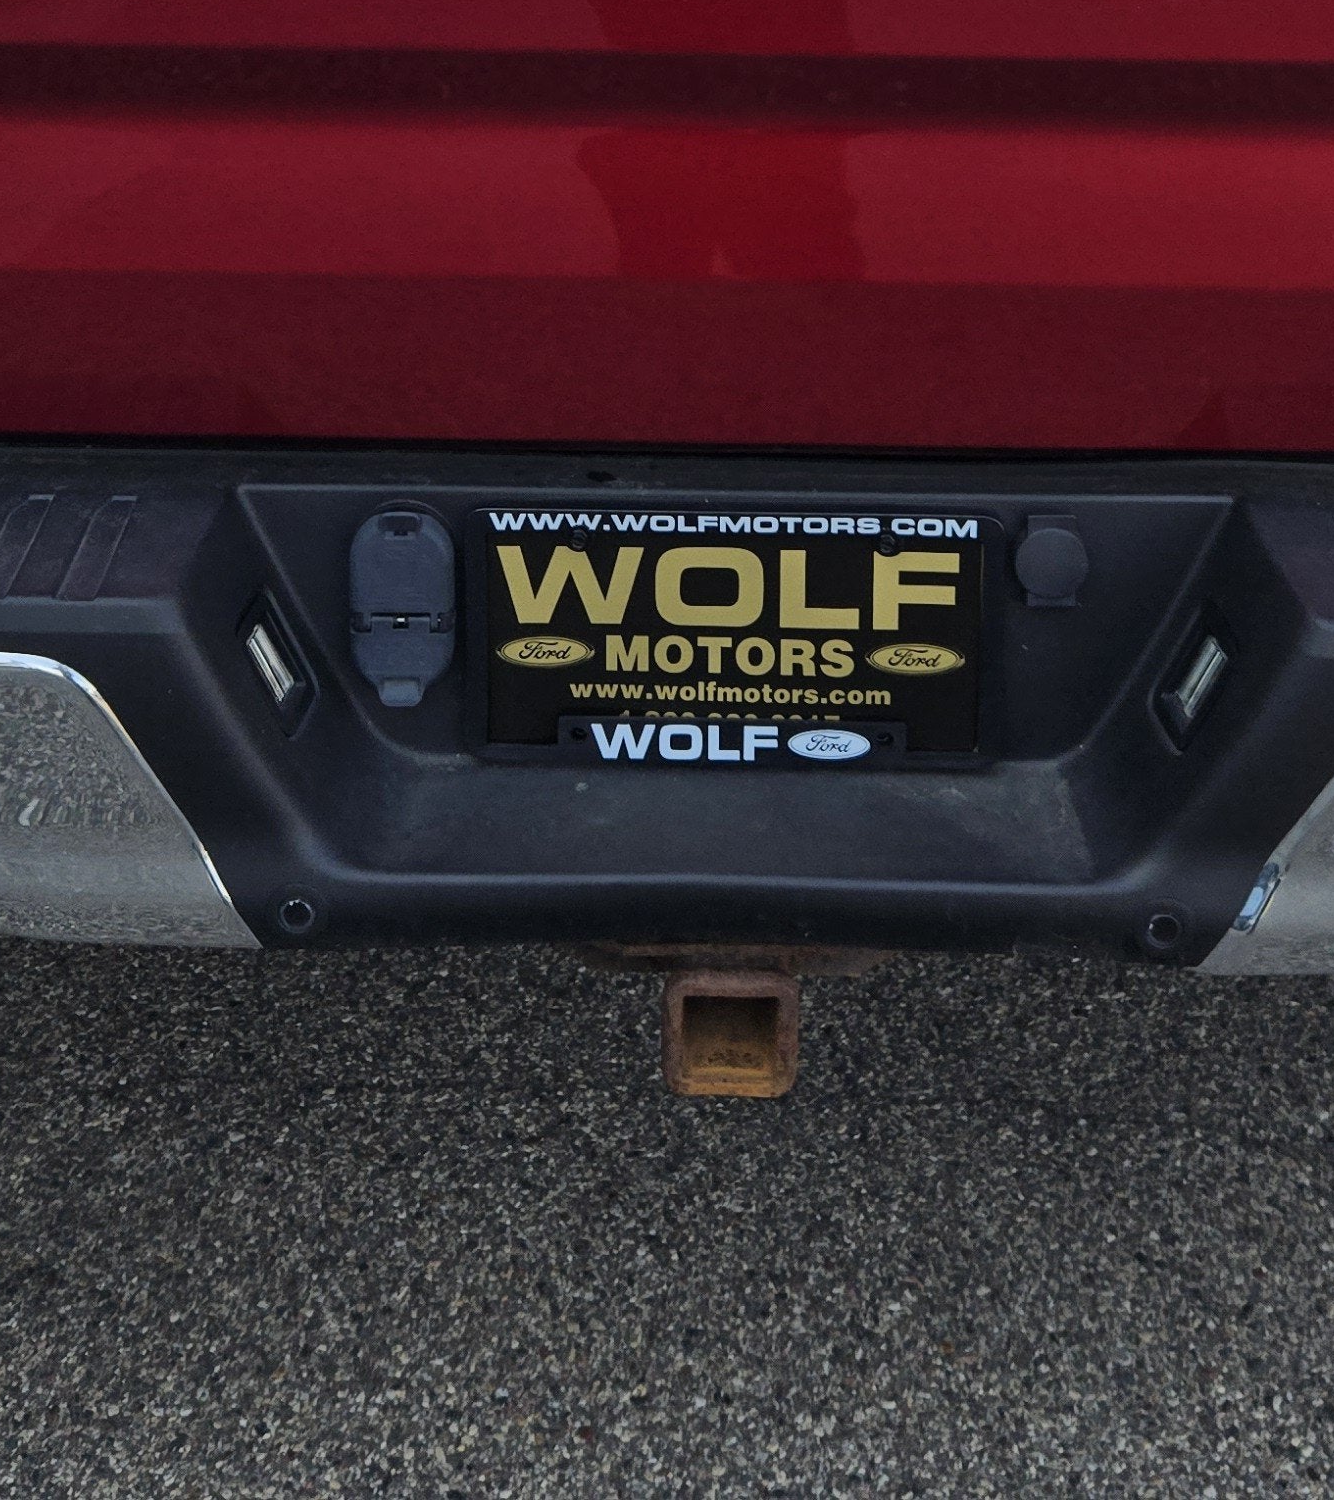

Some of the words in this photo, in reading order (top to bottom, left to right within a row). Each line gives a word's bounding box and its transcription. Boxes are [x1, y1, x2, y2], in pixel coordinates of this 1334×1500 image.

[489, 512, 978, 539] WWW.WOLFMOTORSCOM
[496, 545, 960, 630] WOLF
[518, 640, 571, 660] Ford
[605, 635, 854, 677] MOTORS
[888, 647, 942, 668] Ford
[570, 681, 891, 705] www.wolfmotors.com
[590, 723, 779, 761] WOLF
[805, 734, 852, 753] Ford
